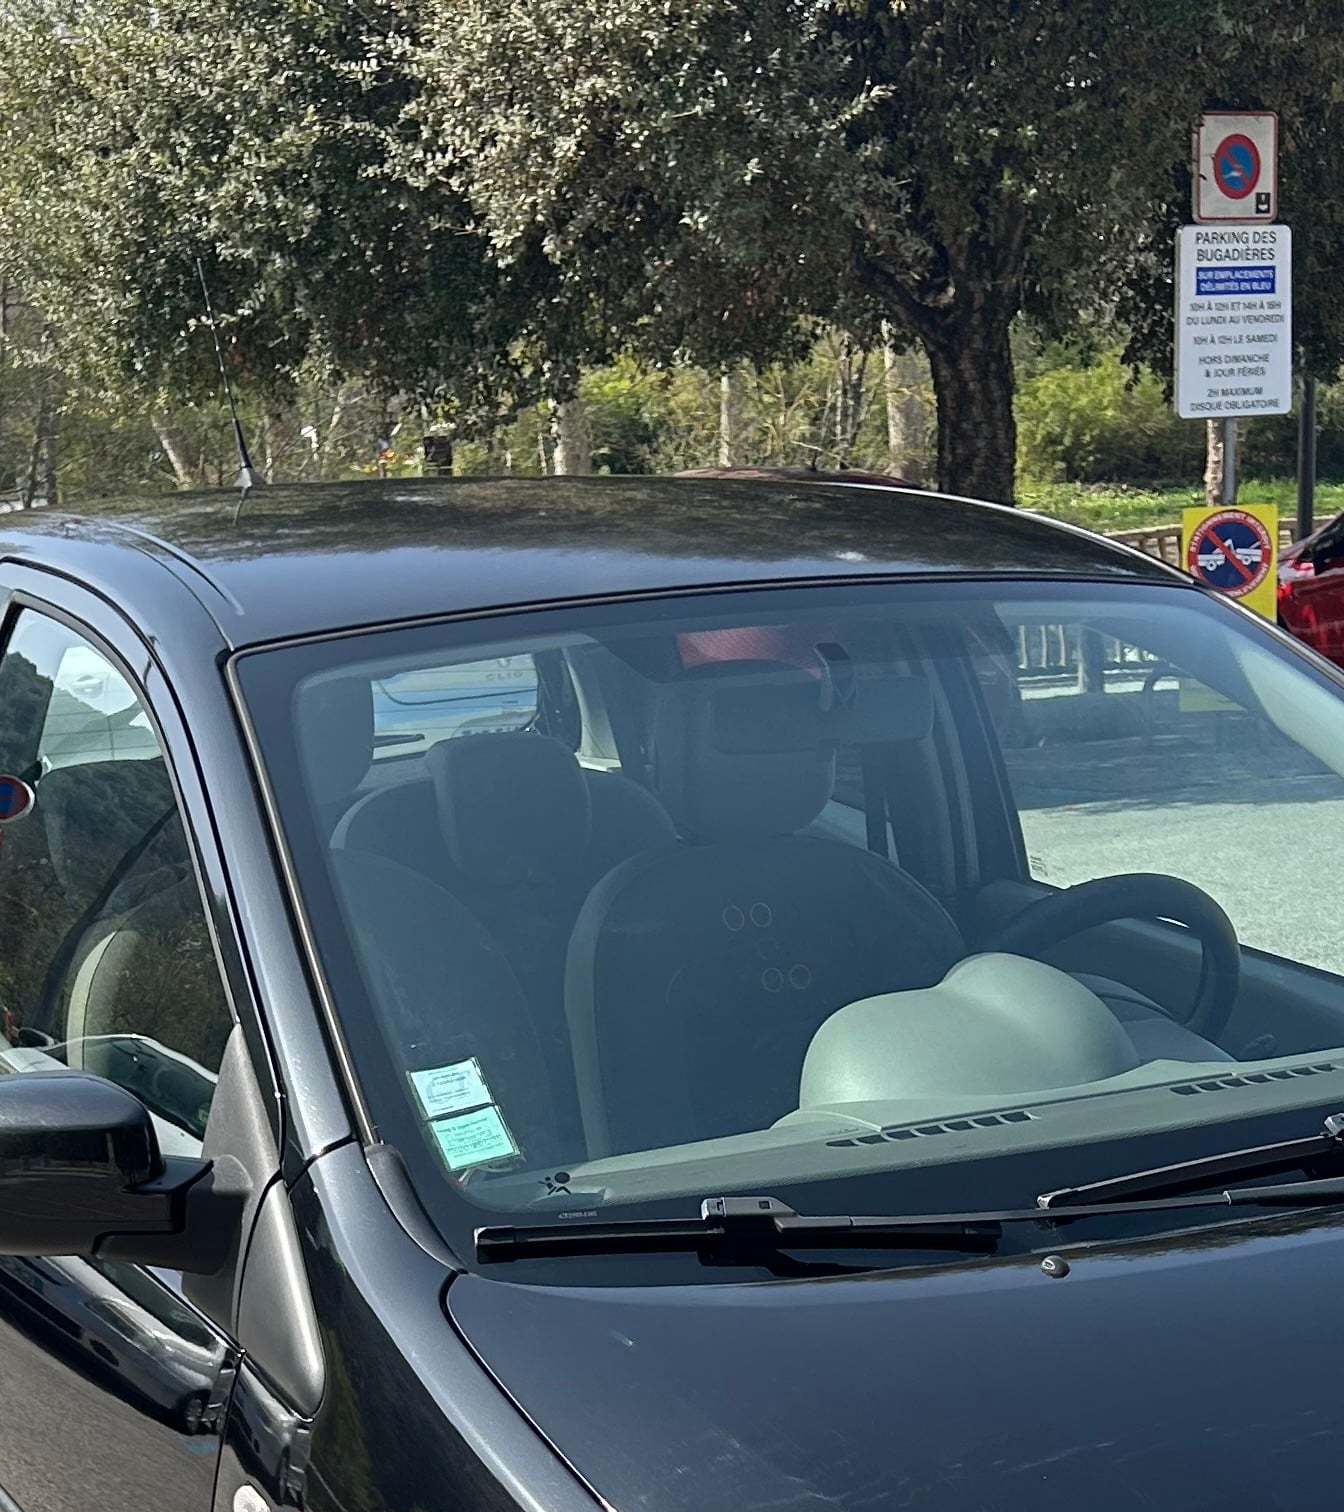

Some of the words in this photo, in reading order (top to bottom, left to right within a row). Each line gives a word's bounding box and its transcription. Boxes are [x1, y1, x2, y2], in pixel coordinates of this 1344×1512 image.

[1196, 231, 1249, 245] PARKING
[1252, 230, 1277, 244] DES
[1196, 244, 1276, 262] BUGADIÈRES
[1186, 316, 1199, 326] DU
[1201, 315, 1227, 325] LUNDI
[1229, 315, 1240, 325] AU
[1242, 314, 1285, 324] VENDREDI
[1233, 335, 1243, 344] LE
[1245, 333, 1278, 344] SAMEDI
